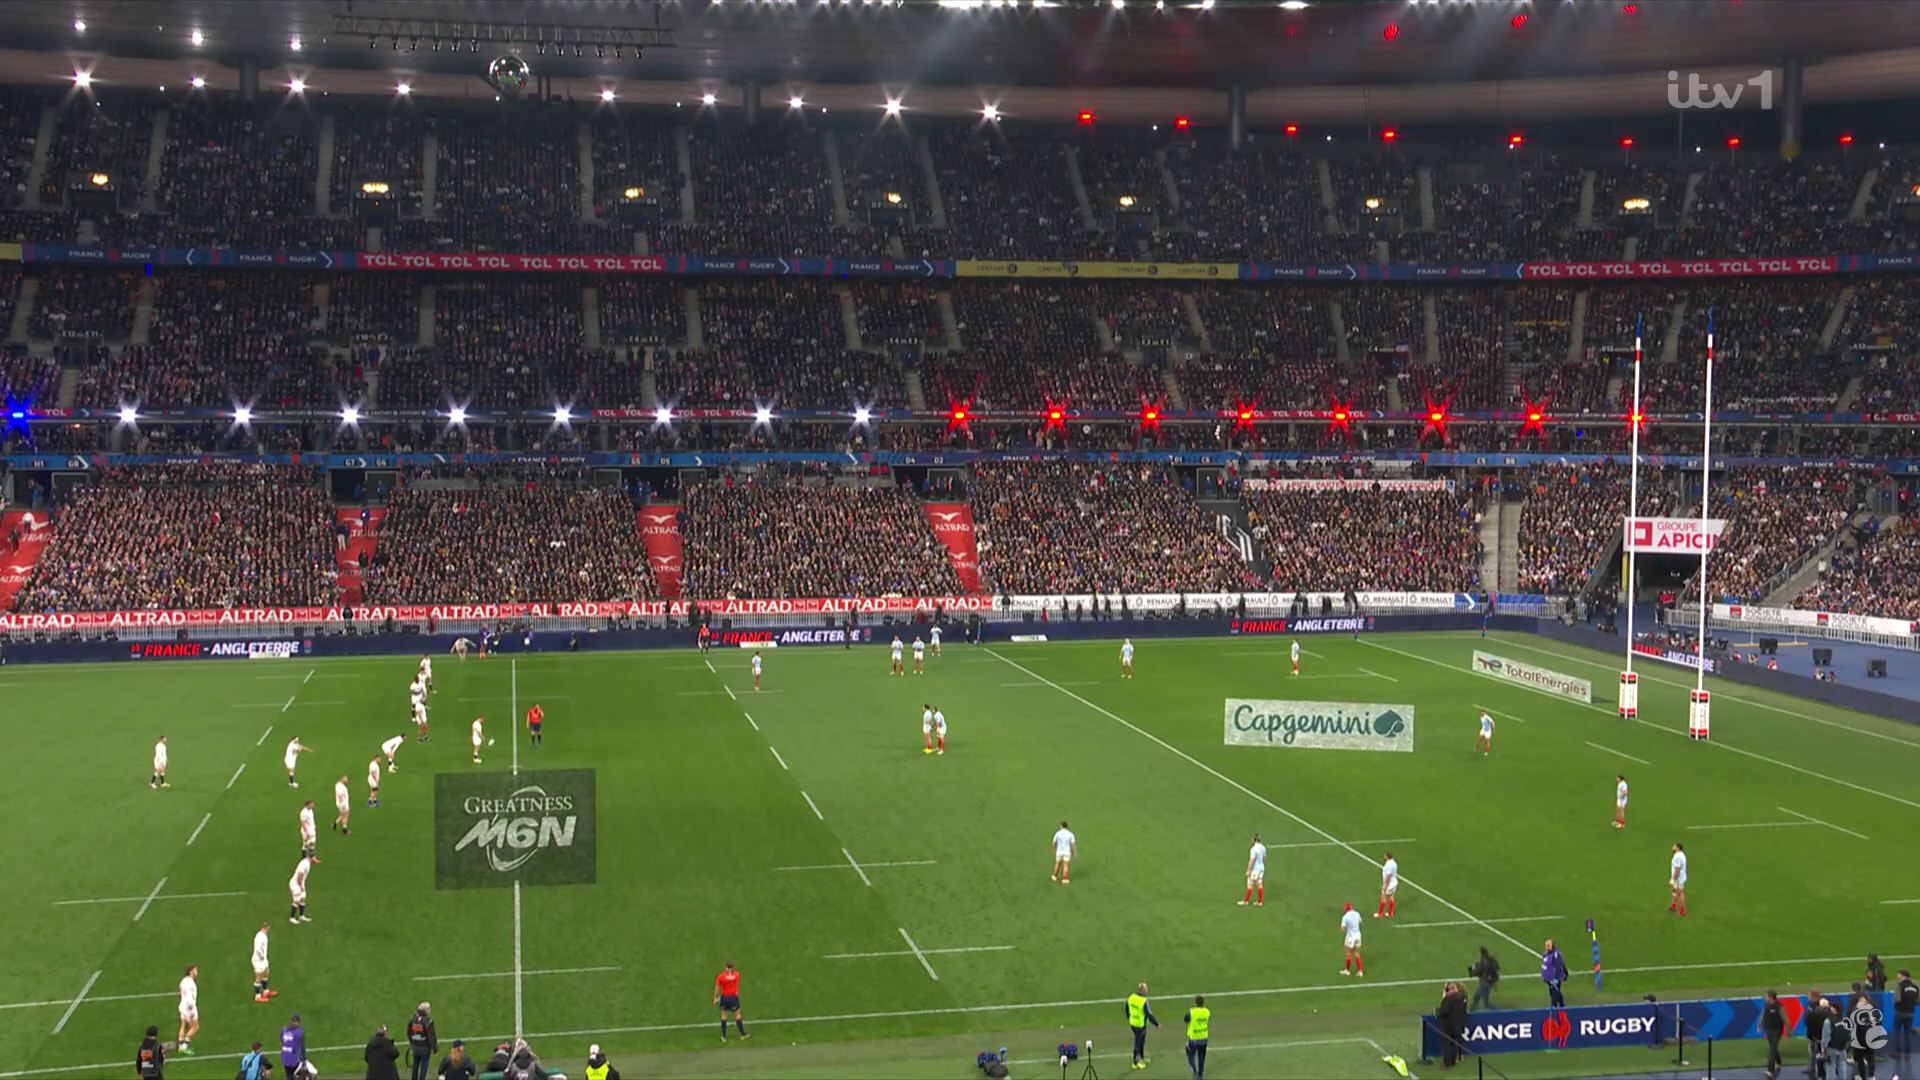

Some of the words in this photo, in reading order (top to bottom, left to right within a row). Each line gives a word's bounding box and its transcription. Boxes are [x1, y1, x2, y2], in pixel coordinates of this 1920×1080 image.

[364, 254, 396, 266] TCL
[402, 255, 434, 266] TCL
[440, 256, 472, 267] TCL
[478, 256, 510, 268] TCL
[520, 257, 552, 268] TCL
[557, 258, 588, 269] TCL
[594, 258, 625, 270] TCL
[630, 258, 662, 270] TCL
[1529, 266, 1560, 276] TCL
[1566, 265, 1597, 276] TCL
[1602, 264, 1634, 275] TCL
[1640, 263, 1672, 274] TCL
[1682, 262, 1714, 273] TCL
[1720, 262, 1752, 273] TCL
[1758, 260, 1791, 272] TCL
[1797, 259, 1830, 271] TCL
[643, 526, 678, 535] ALTRAD
[935, 523, 970, 532] ALTRAD
[1657, 521, 1698, 532] GROUPE
[531, 603, 598, 616] ALRAD
[725, 598, 791, 614] ALTRAD
[821, 598, 886, 612] ALTRAD
[916, 598, 980, 611] ALTRAD
[110, 611, 186, 626] ALTRAD
[219, 608, 293, 625] ALTRAD
[431, 606, 498, 619] ALTRAD
[0, 613, 75, 628] ALTRAD
[1241, 620, 1287, 633] FRANCE
[1294, 618, 1364, 631] ANGLETERRE
[722, 631, 773, 644] FRANCE
[143, 644, 200, 657] FRANCE
[210, 641, 300, 655] ANGLETERRE
[1667, 650, 1714, 672] ANGLETERE
[1505, 663, 1587, 696] TotalEnergies
[1234, 704, 1371, 744] Capgemini
[1462, 1022, 1532, 1041] RANCE
[1580, 1016, 1656, 1036] RUGBY
